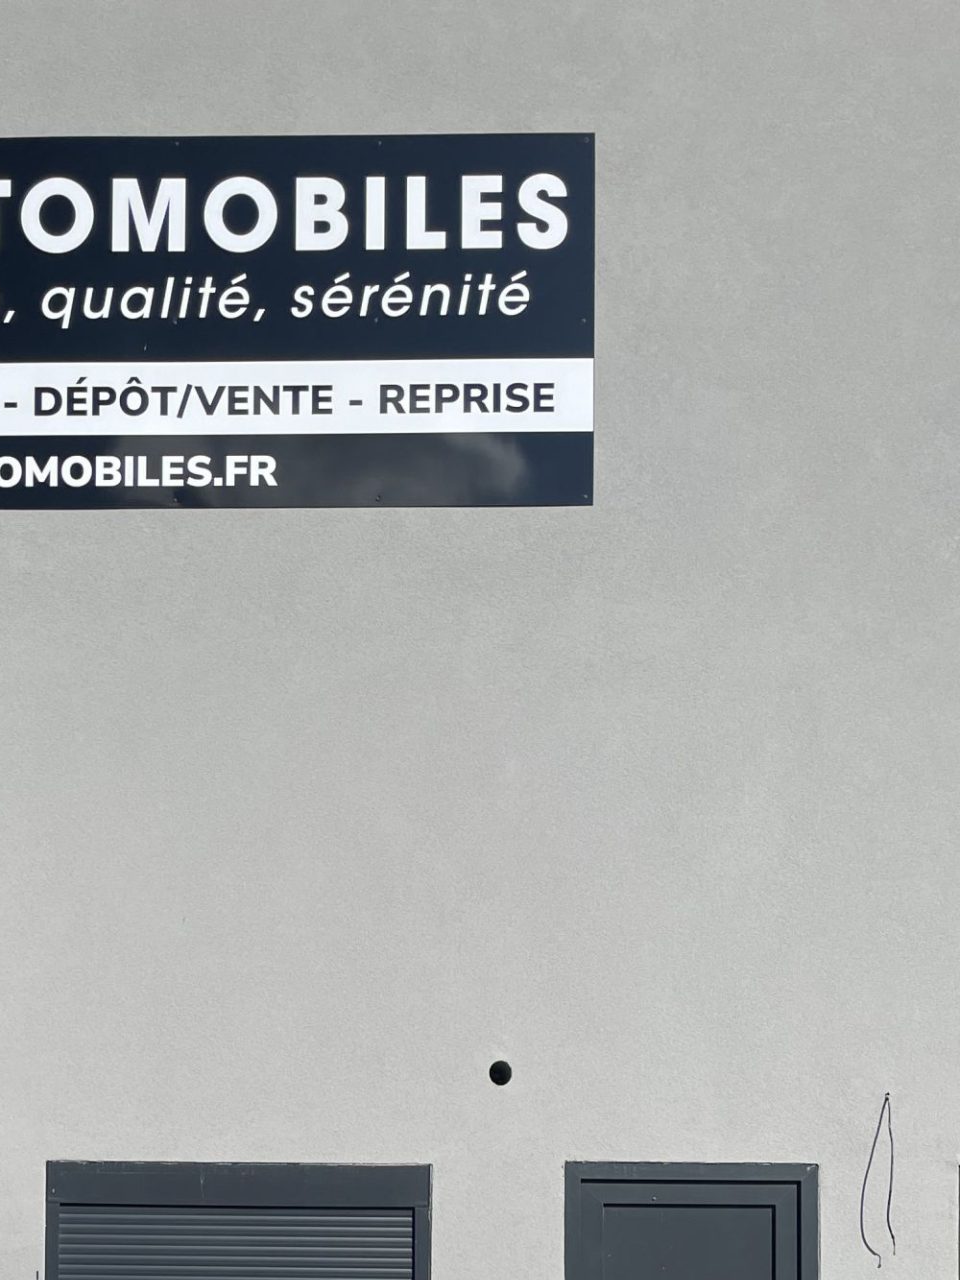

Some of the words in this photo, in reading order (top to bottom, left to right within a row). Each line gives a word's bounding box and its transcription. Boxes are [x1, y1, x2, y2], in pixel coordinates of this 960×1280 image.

[42, 273, 265, 329] qualité,
[291, 270, 530, 318] sérénité
[35, 377, 332, 418] DÉPÔT/VENTE
[380, 383, 554, 413] REPRISE
